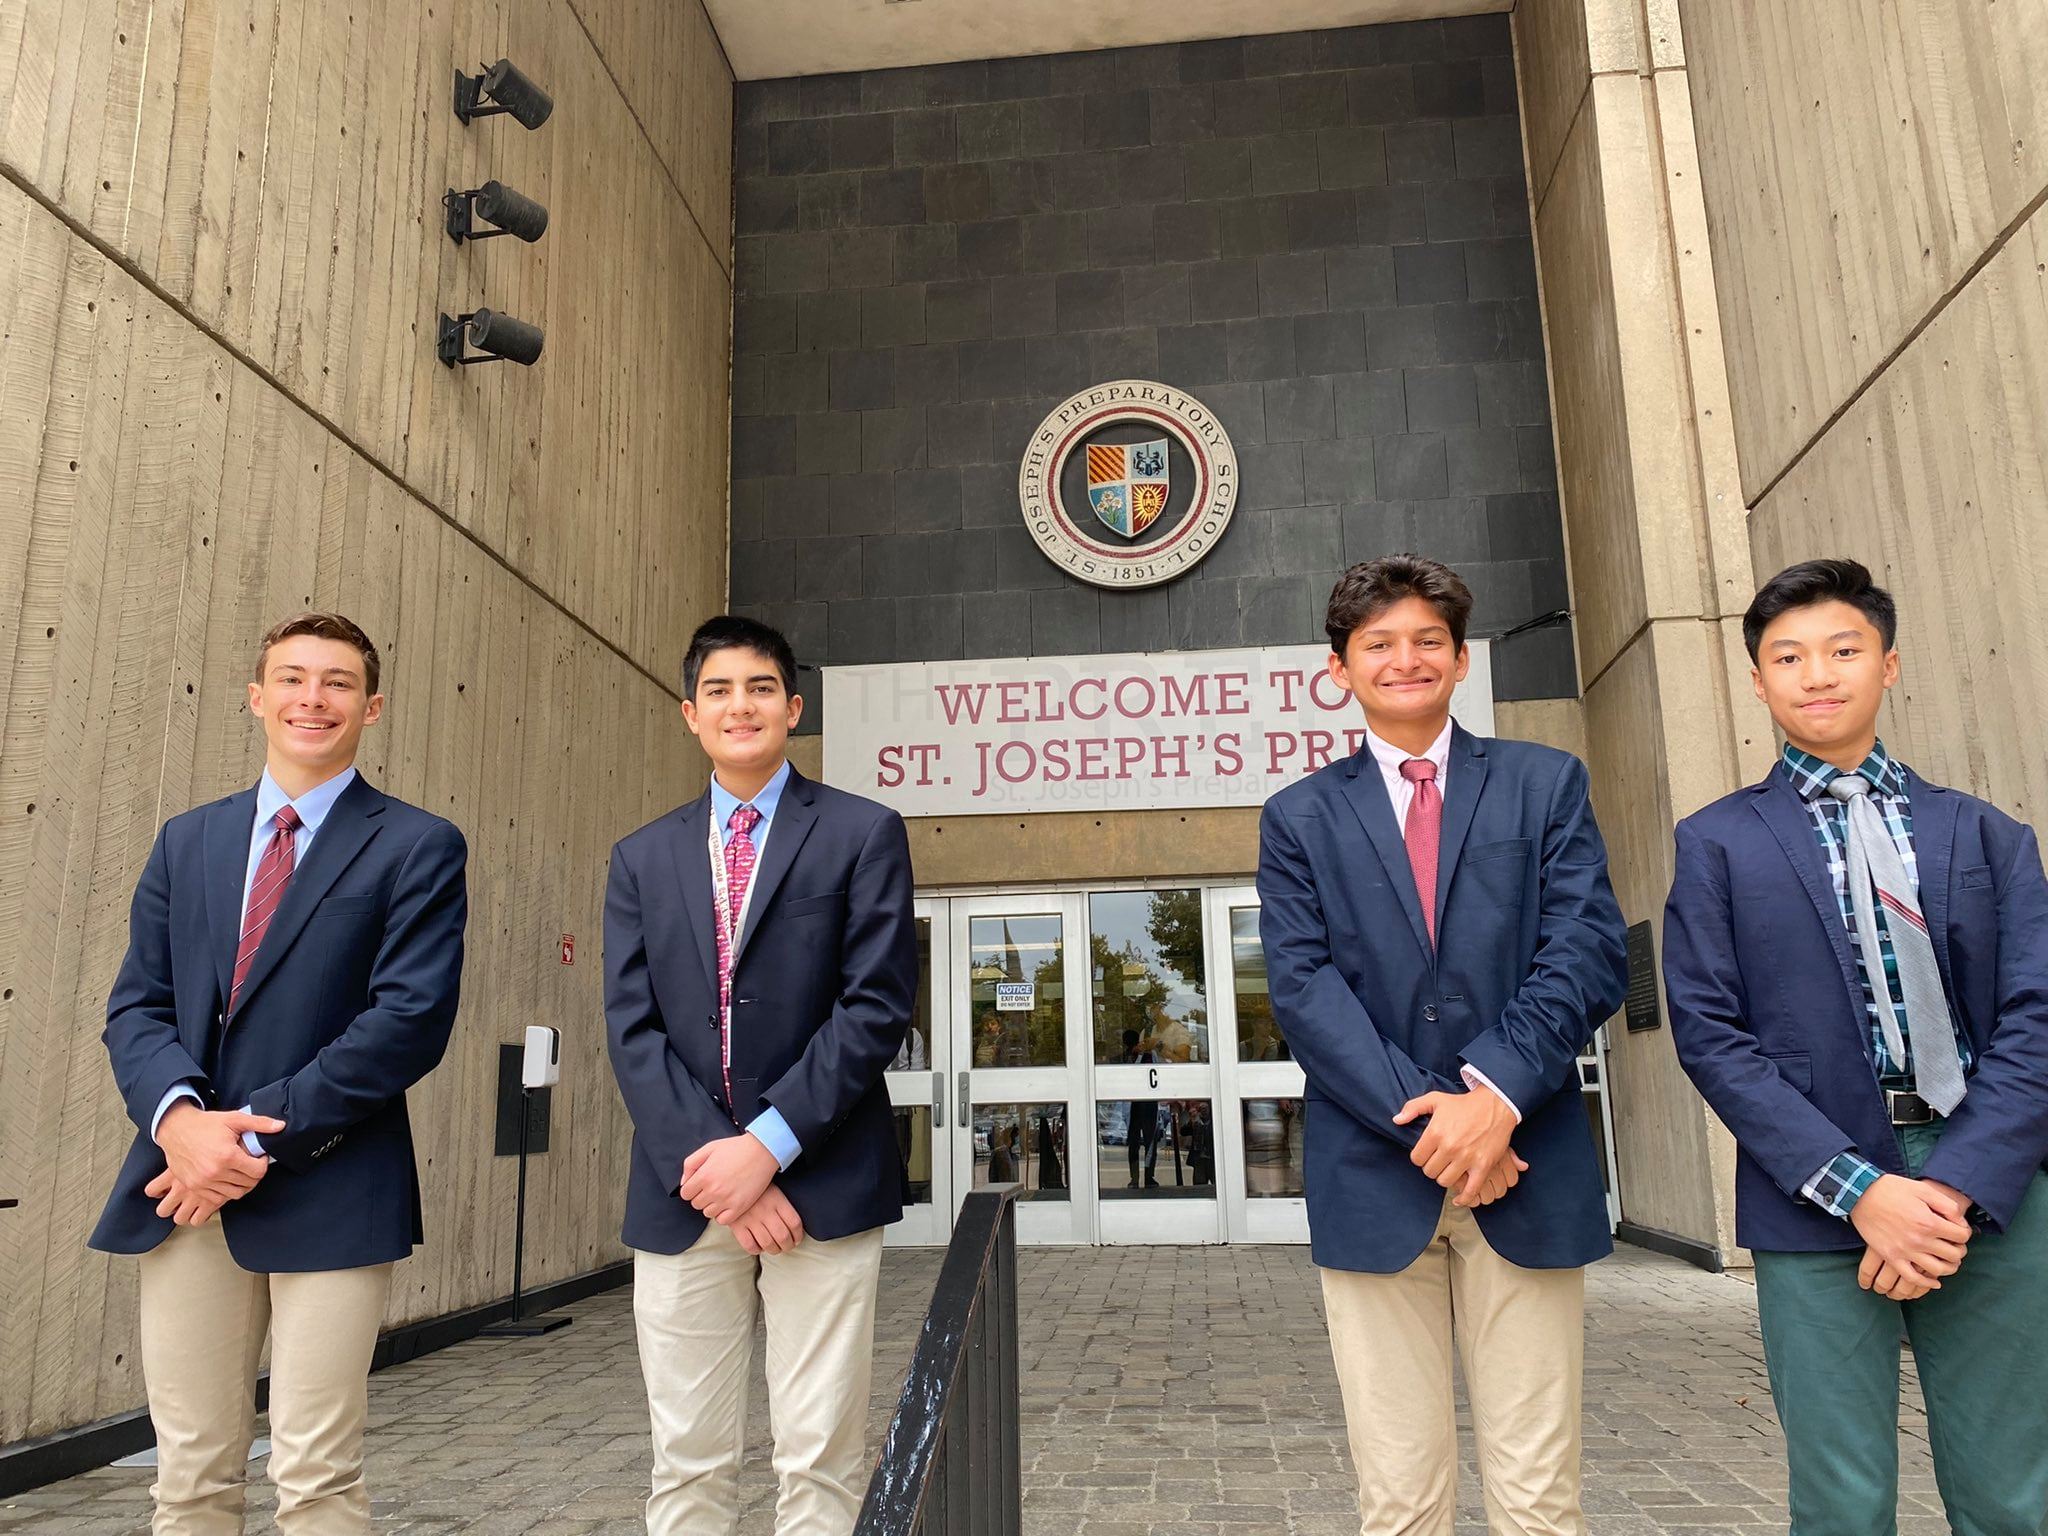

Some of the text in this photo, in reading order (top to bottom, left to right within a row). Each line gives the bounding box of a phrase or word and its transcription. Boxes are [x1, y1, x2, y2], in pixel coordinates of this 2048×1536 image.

[1026, 386, 1231, 574] ST. JOSEPH'S PREPARATORY SCHOOL
[1111, 564, 1156, 580] 1851
[934, 667, 1354, 725] WELCOME TO
[876, 728, 1367, 796] ST. JOSEPH'S PRE
[999, 985, 1032, 993] NOTICE
[1149, 1068, 1158, 1089] C
